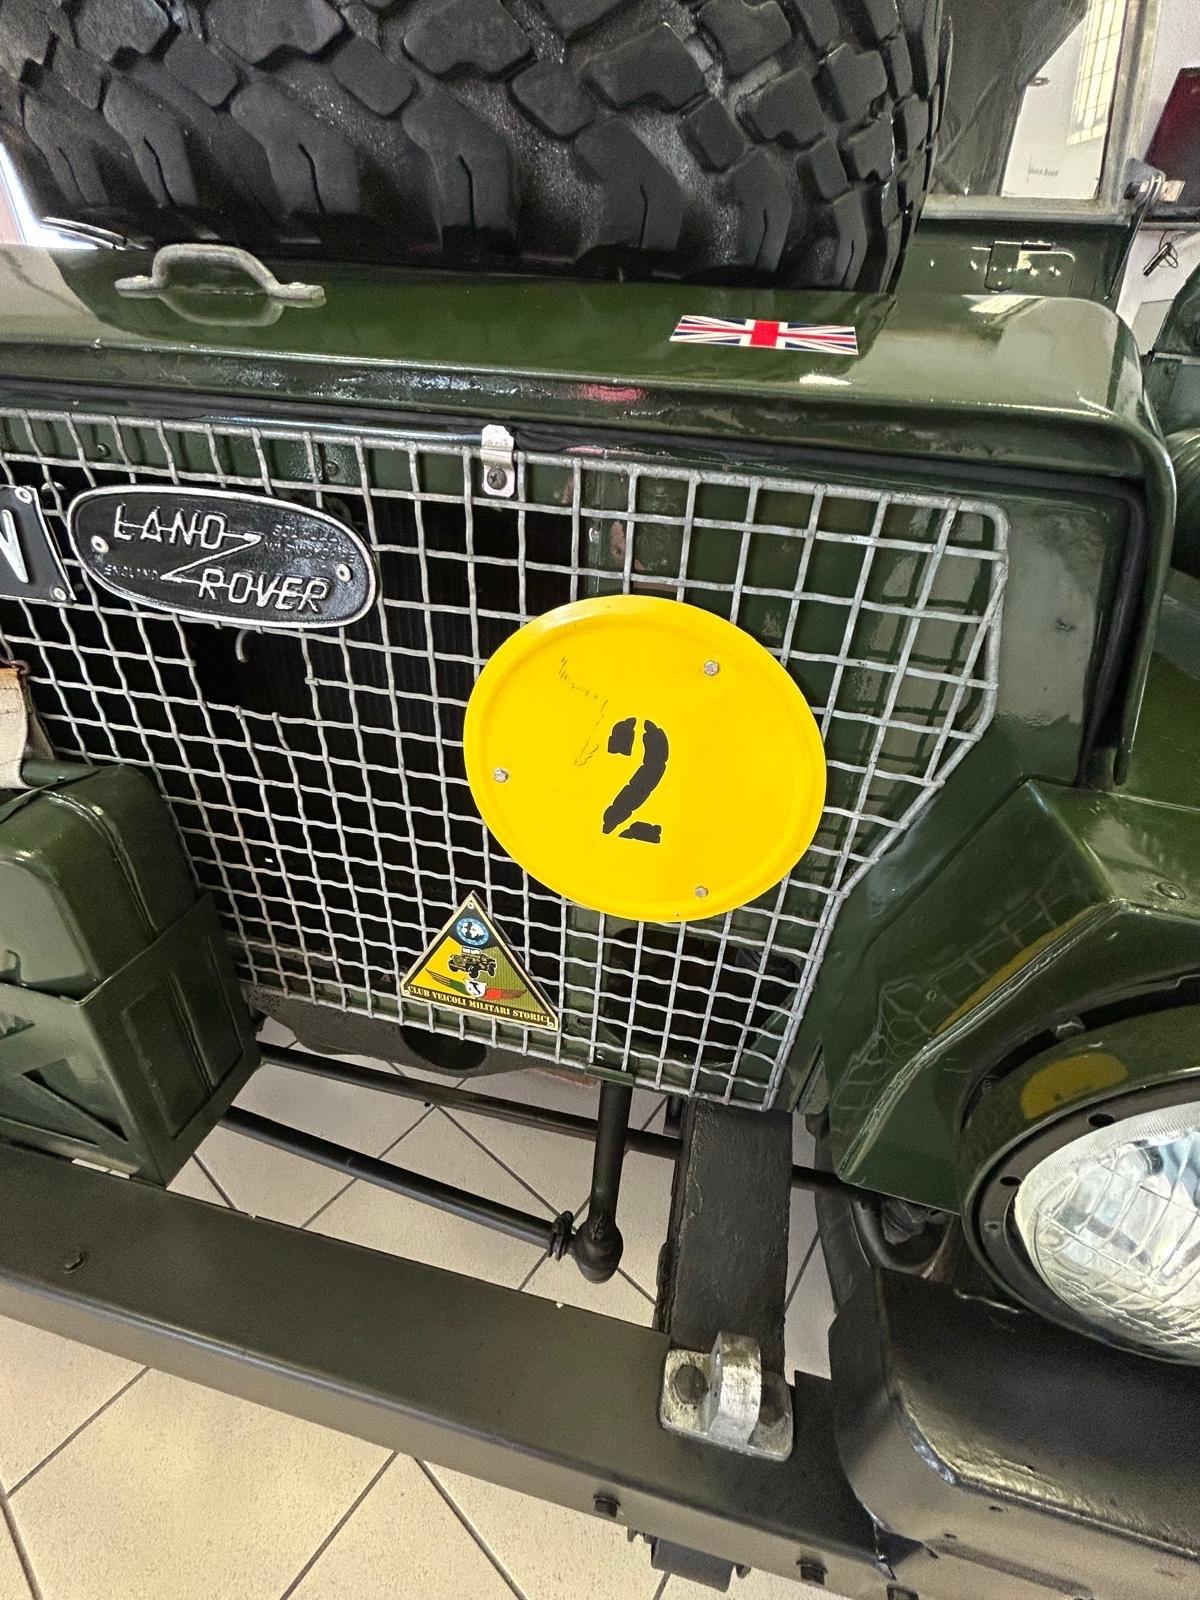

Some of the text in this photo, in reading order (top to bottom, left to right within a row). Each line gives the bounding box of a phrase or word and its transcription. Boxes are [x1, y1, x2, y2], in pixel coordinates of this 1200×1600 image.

[113, 503, 228, 550] LAND
[198, 567, 331, 612] ROVER
[602, 717, 669, 843] 2
[408, 986, 550, 1023] CLUB VEICOLI MILITARI STORICI
